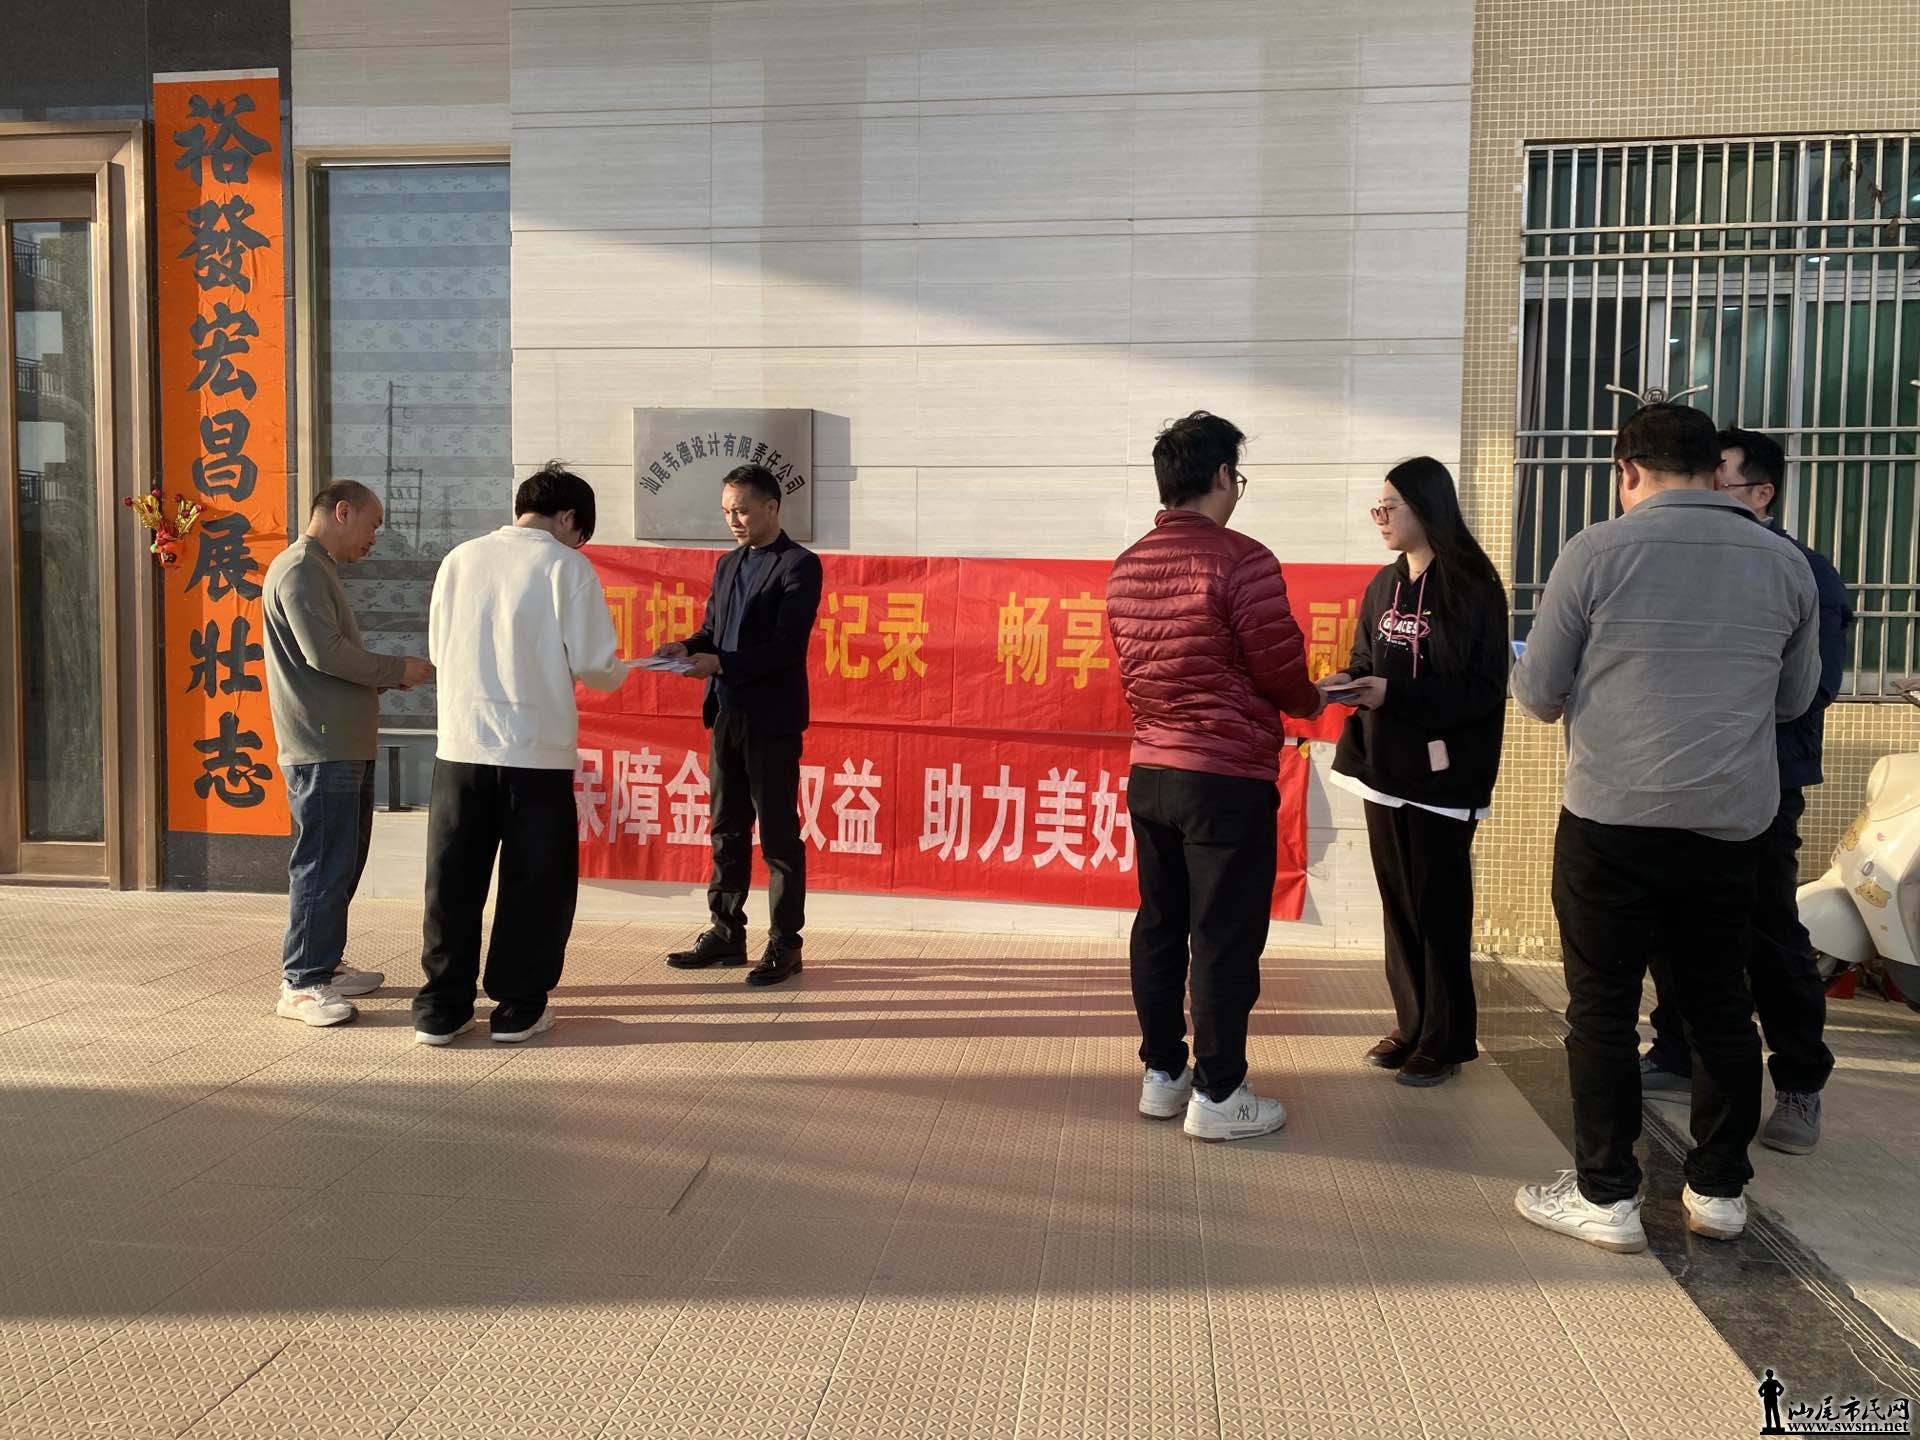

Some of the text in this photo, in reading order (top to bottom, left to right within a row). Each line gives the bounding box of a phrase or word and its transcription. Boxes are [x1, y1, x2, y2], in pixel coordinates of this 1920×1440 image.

[639, 432, 806, 496] 汕尾韦德设计有限责任公司
